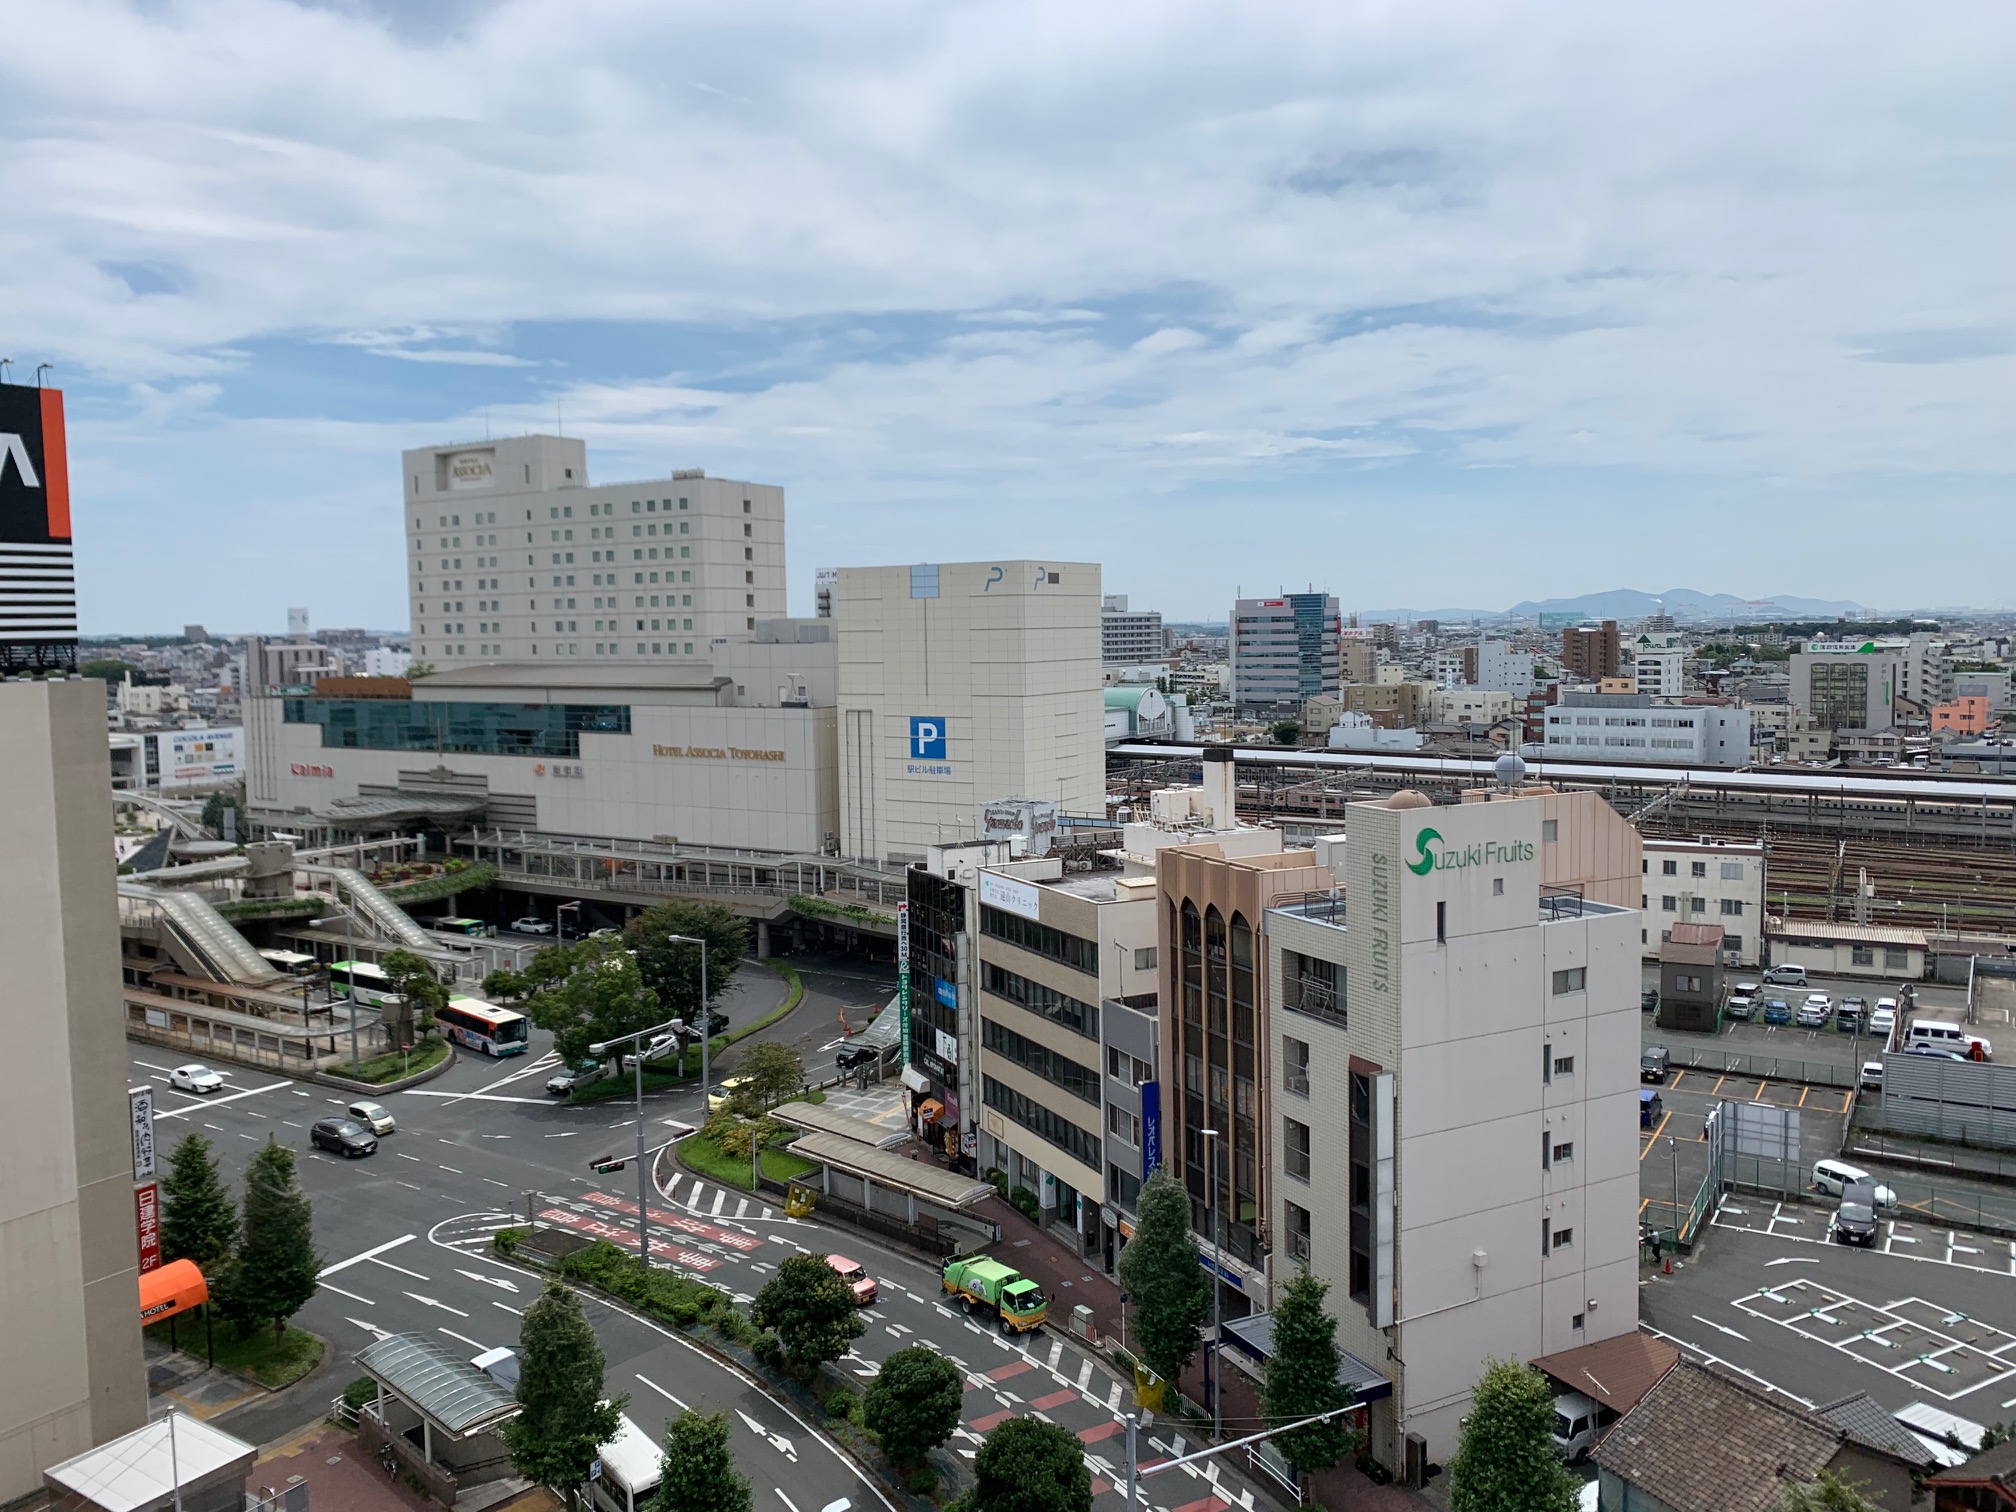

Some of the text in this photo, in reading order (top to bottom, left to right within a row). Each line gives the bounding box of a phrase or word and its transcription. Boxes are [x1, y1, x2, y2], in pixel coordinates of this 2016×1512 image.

[918, 722, 938, 755] P
[906, 764, 951, 776] 駅ビル駐車場
[1485, 839, 1534, 865] Fruits
[1371, 852, 1389, 993] SUZUKI FRUITS
[138, 1189, 157, 1250] 日建学院
[141, 1254, 158, 1270] 2F
[144, 1303, 169, 1318] HOTEL
